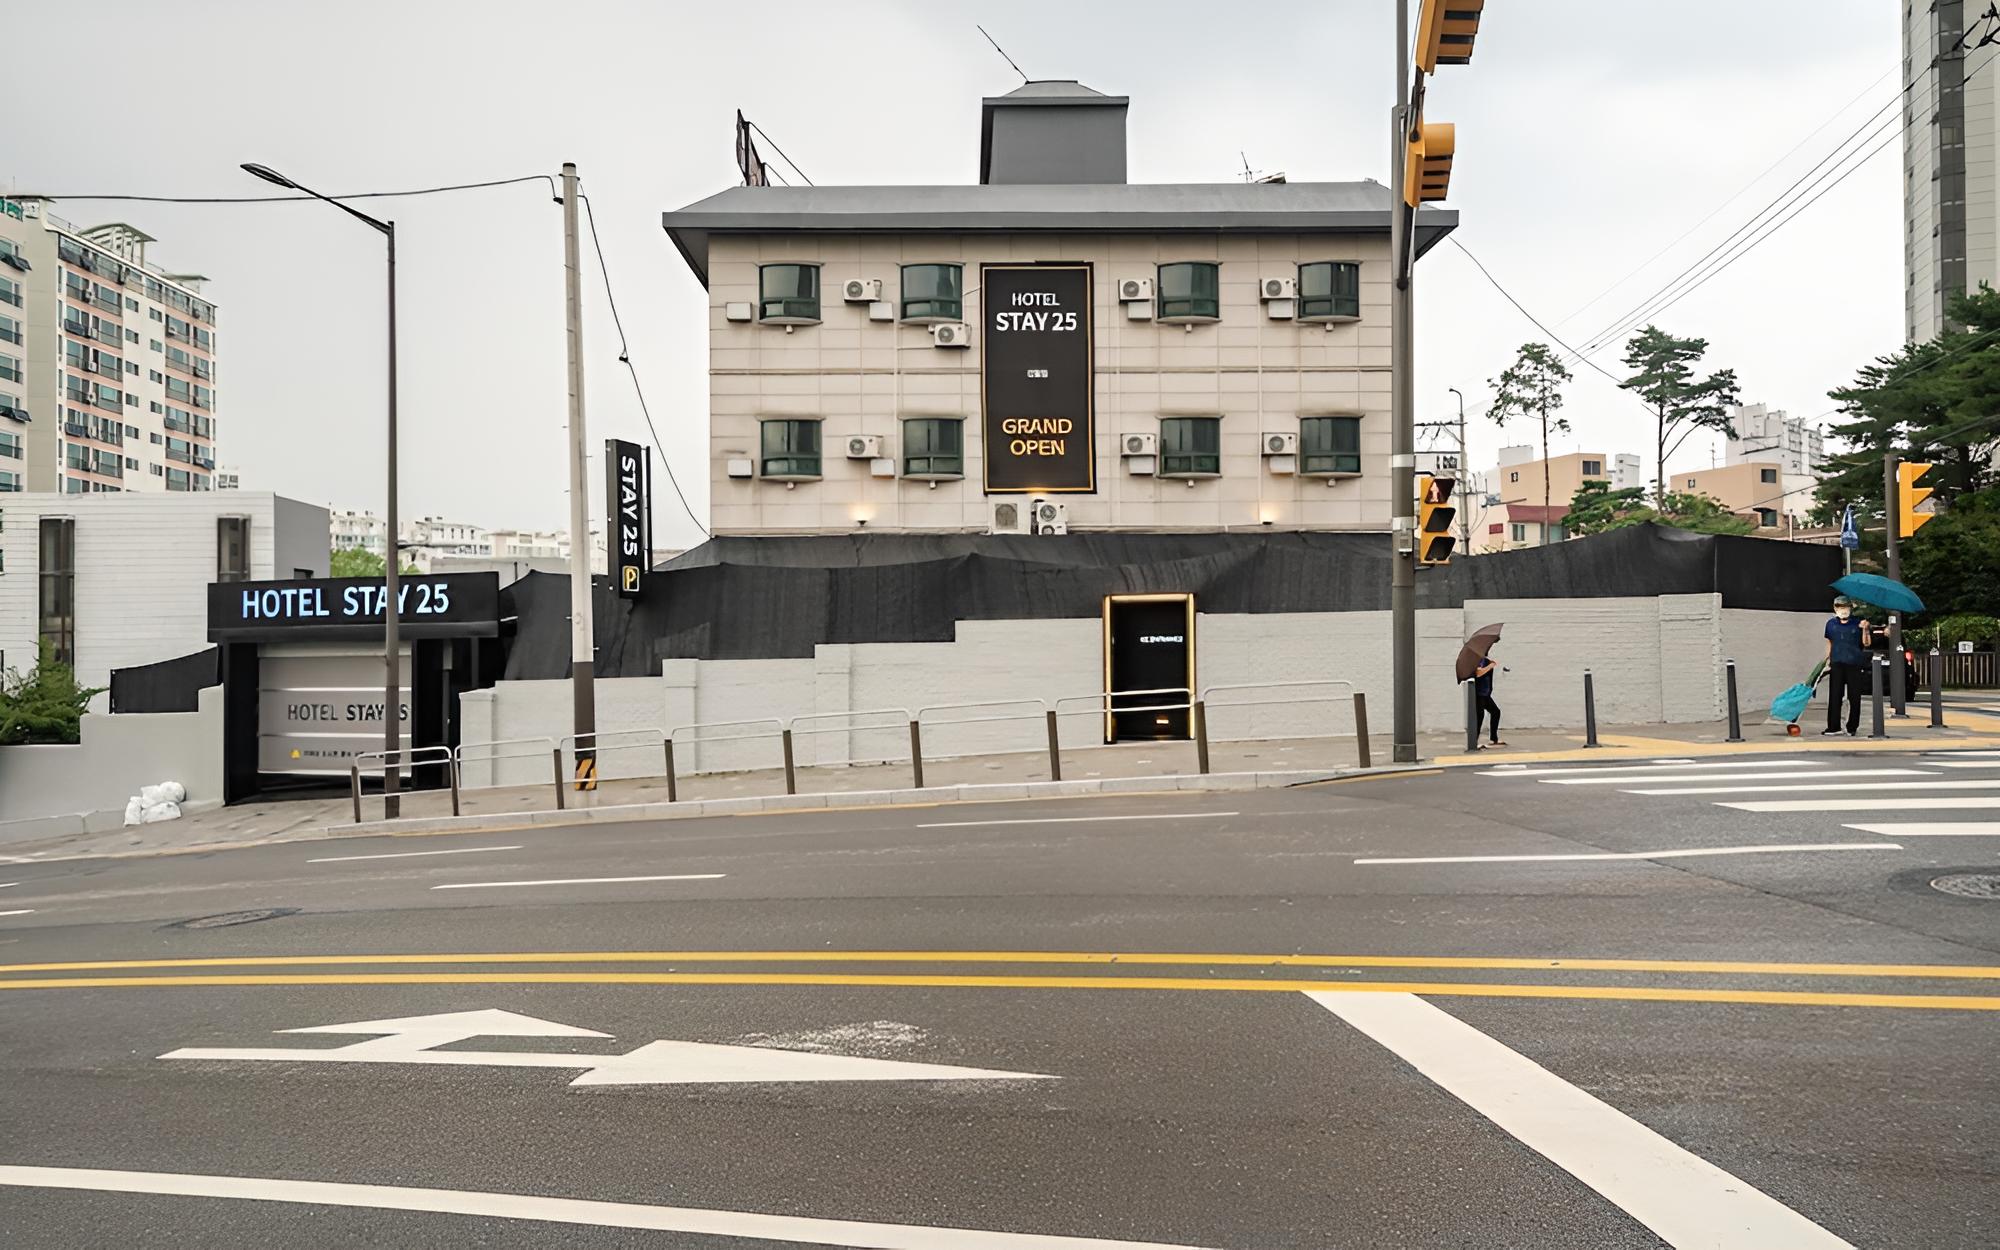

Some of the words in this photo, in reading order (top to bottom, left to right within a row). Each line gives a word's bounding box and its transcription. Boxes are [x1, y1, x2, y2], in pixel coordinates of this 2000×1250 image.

[1011, 292, 1060, 306] HOTEL
[995, 312, 1048, 331] STAY
[1051, 312, 1077, 331] 25
[1002, 418, 1073, 435] GRAND
[1010, 439, 1065, 456] OPEN
[621, 455, 638, 521] STAY
[623, 524, 638, 556] 25
[242, 588, 330, 618] HOTEL
[343, 584, 410, 616] STAY
[416, 583, 449, 614] 25
[287, 703, 338, 721] HOTEL
[346, 703, 385, 721] STAY
